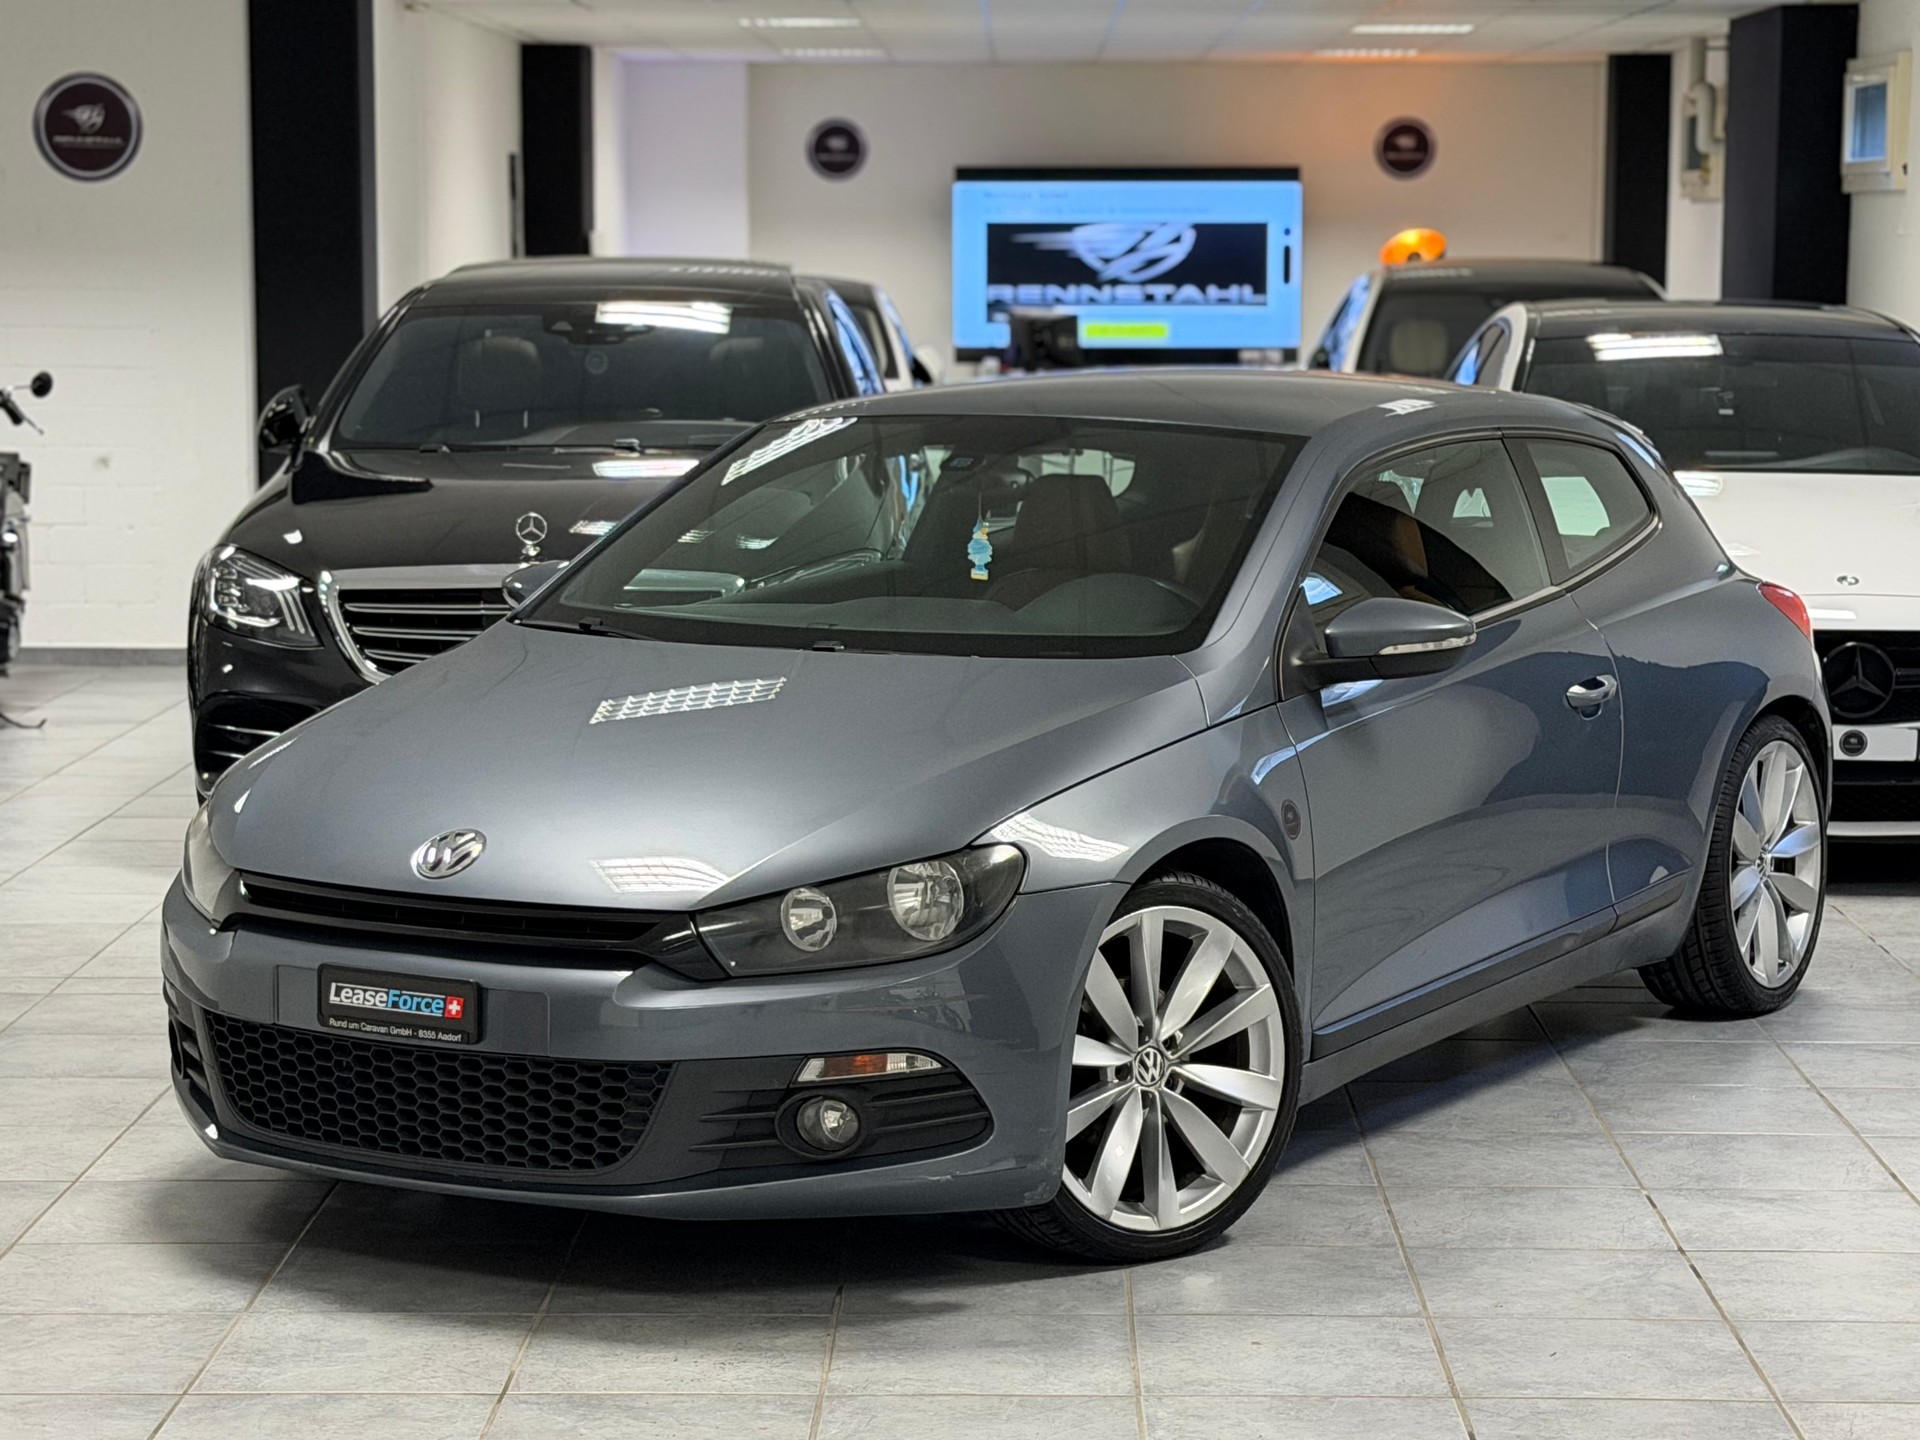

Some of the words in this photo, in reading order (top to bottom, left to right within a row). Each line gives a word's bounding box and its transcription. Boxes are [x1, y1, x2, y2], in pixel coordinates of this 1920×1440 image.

[986, 283, 1267, 304] RENNSTAHL
[329, 982, 444, 1014] LeaseForce
[329, 1017, 348, 1029] Rund
[348, 1022, 360, 1030] um
[360, 1021, 389, 1034] Caravan
[389, 1025, 413, 1037] GmbH
[418, 1029, 437, 1040] 8355
[437, 1031, 462, 1043] Aadorf
